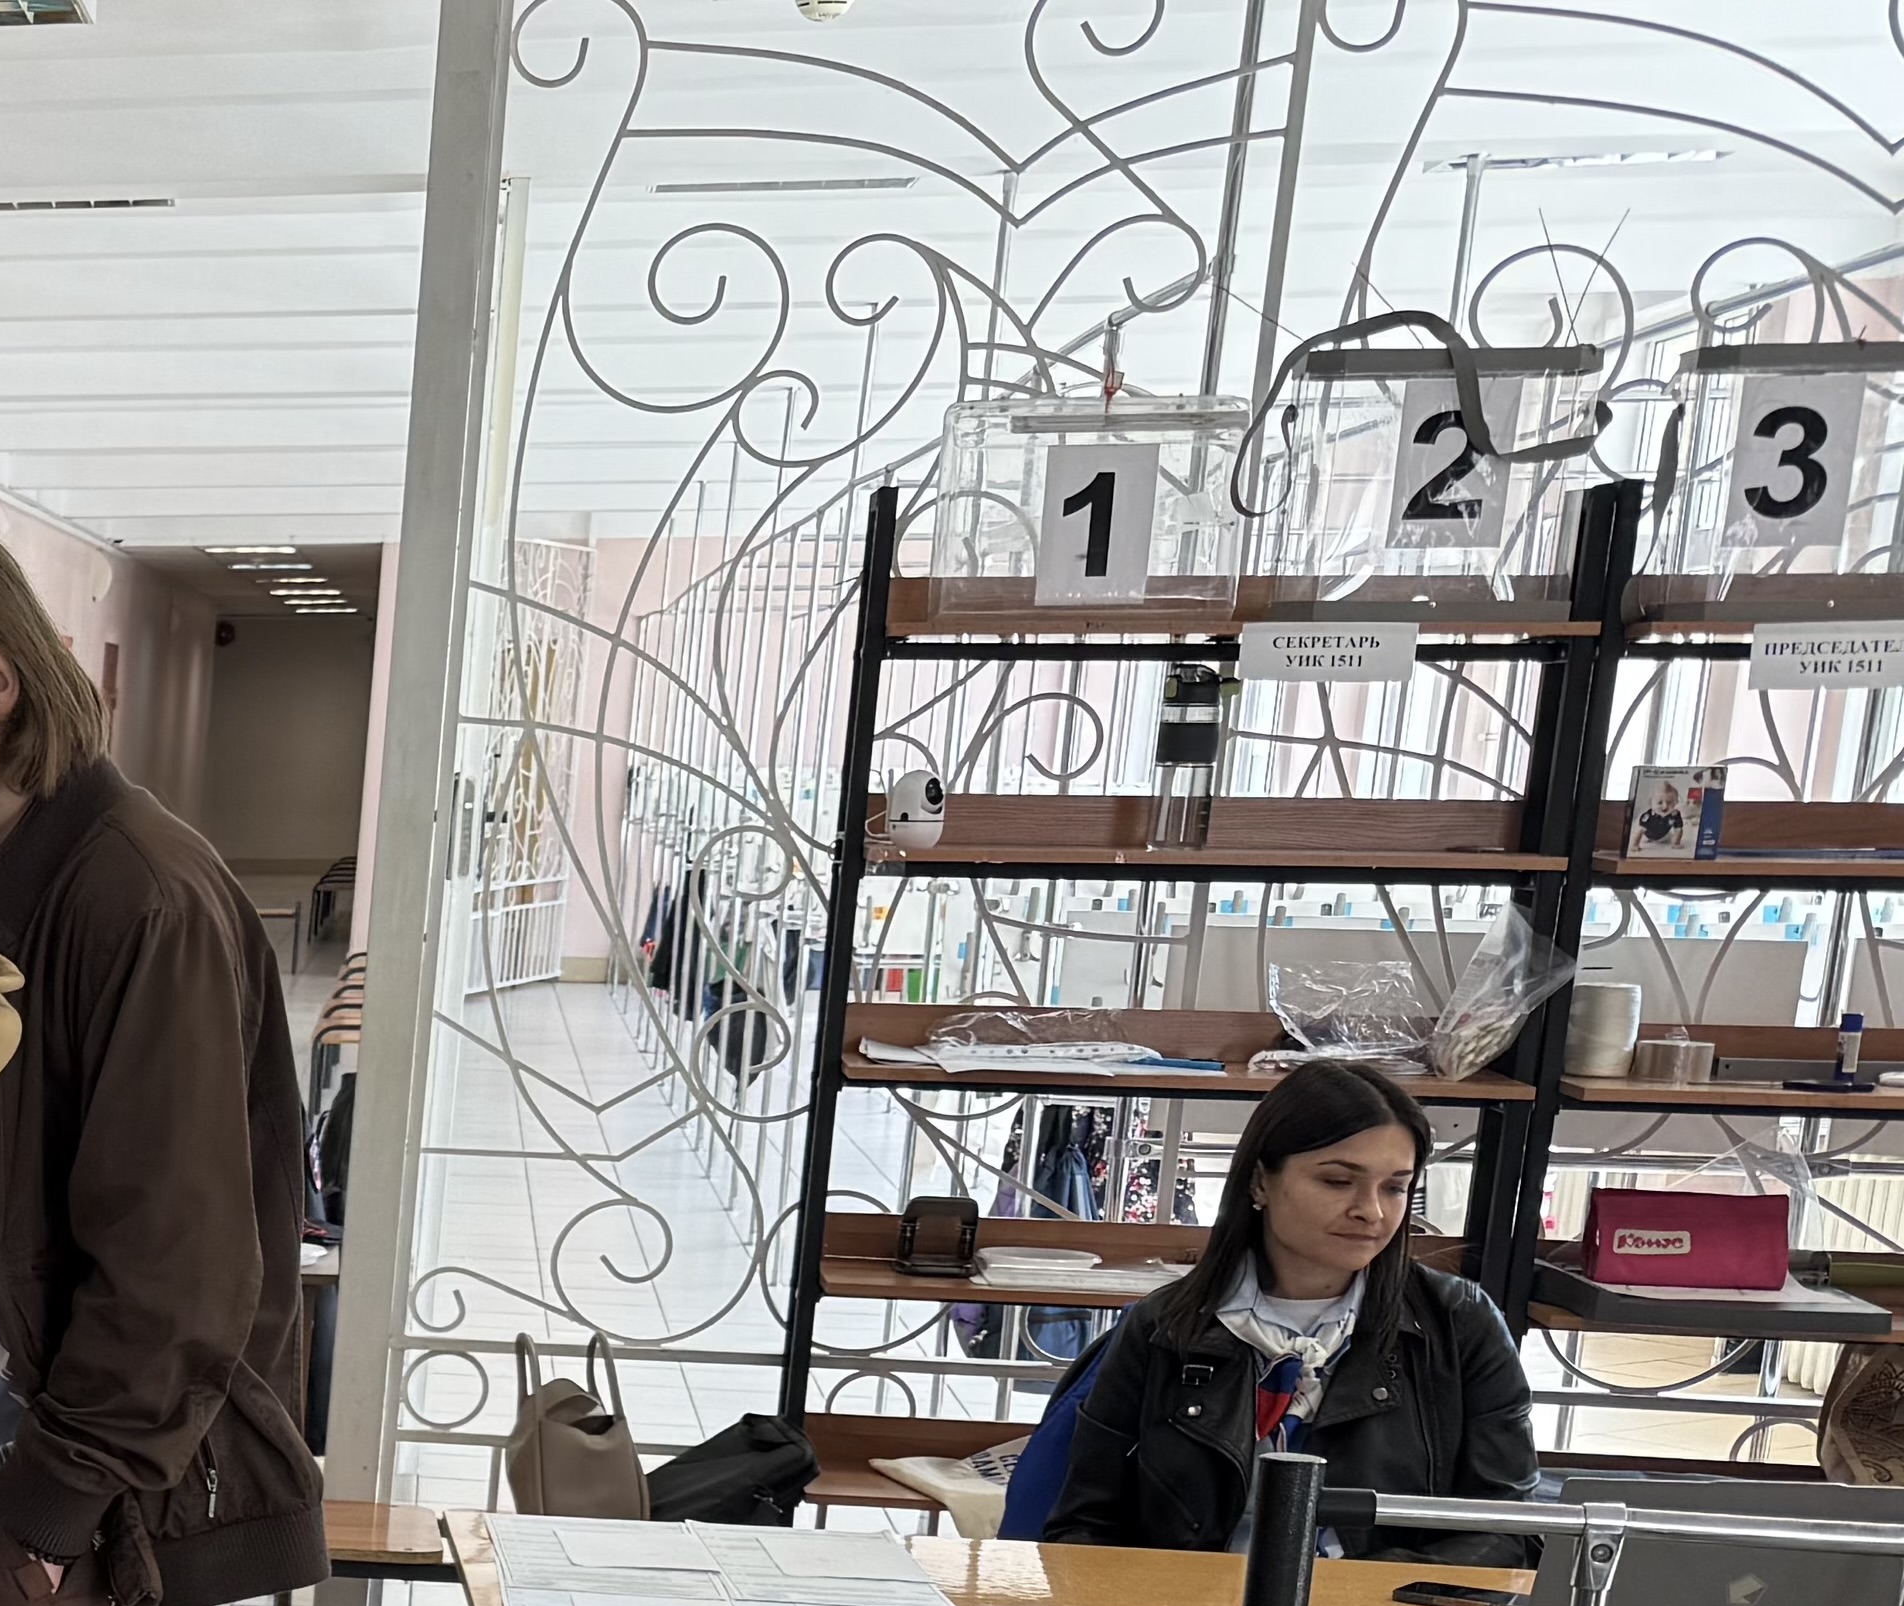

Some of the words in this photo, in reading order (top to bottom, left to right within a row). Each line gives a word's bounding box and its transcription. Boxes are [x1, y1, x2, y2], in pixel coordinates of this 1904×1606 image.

[1402, 410, 1484, 522] 2
[1745, 406, 1828, 519] 3
[1061, 471, 1118, 577] 1
[1272, 634, 1381, 652] СЕКРЕТАРЬ
[1285, 653, 1324, 670] УИК
[1329, 653, 1365, 669] 1511
[1800, 660, 1841, 674] УИК
[1848, 659, 1882, 673] 1511
